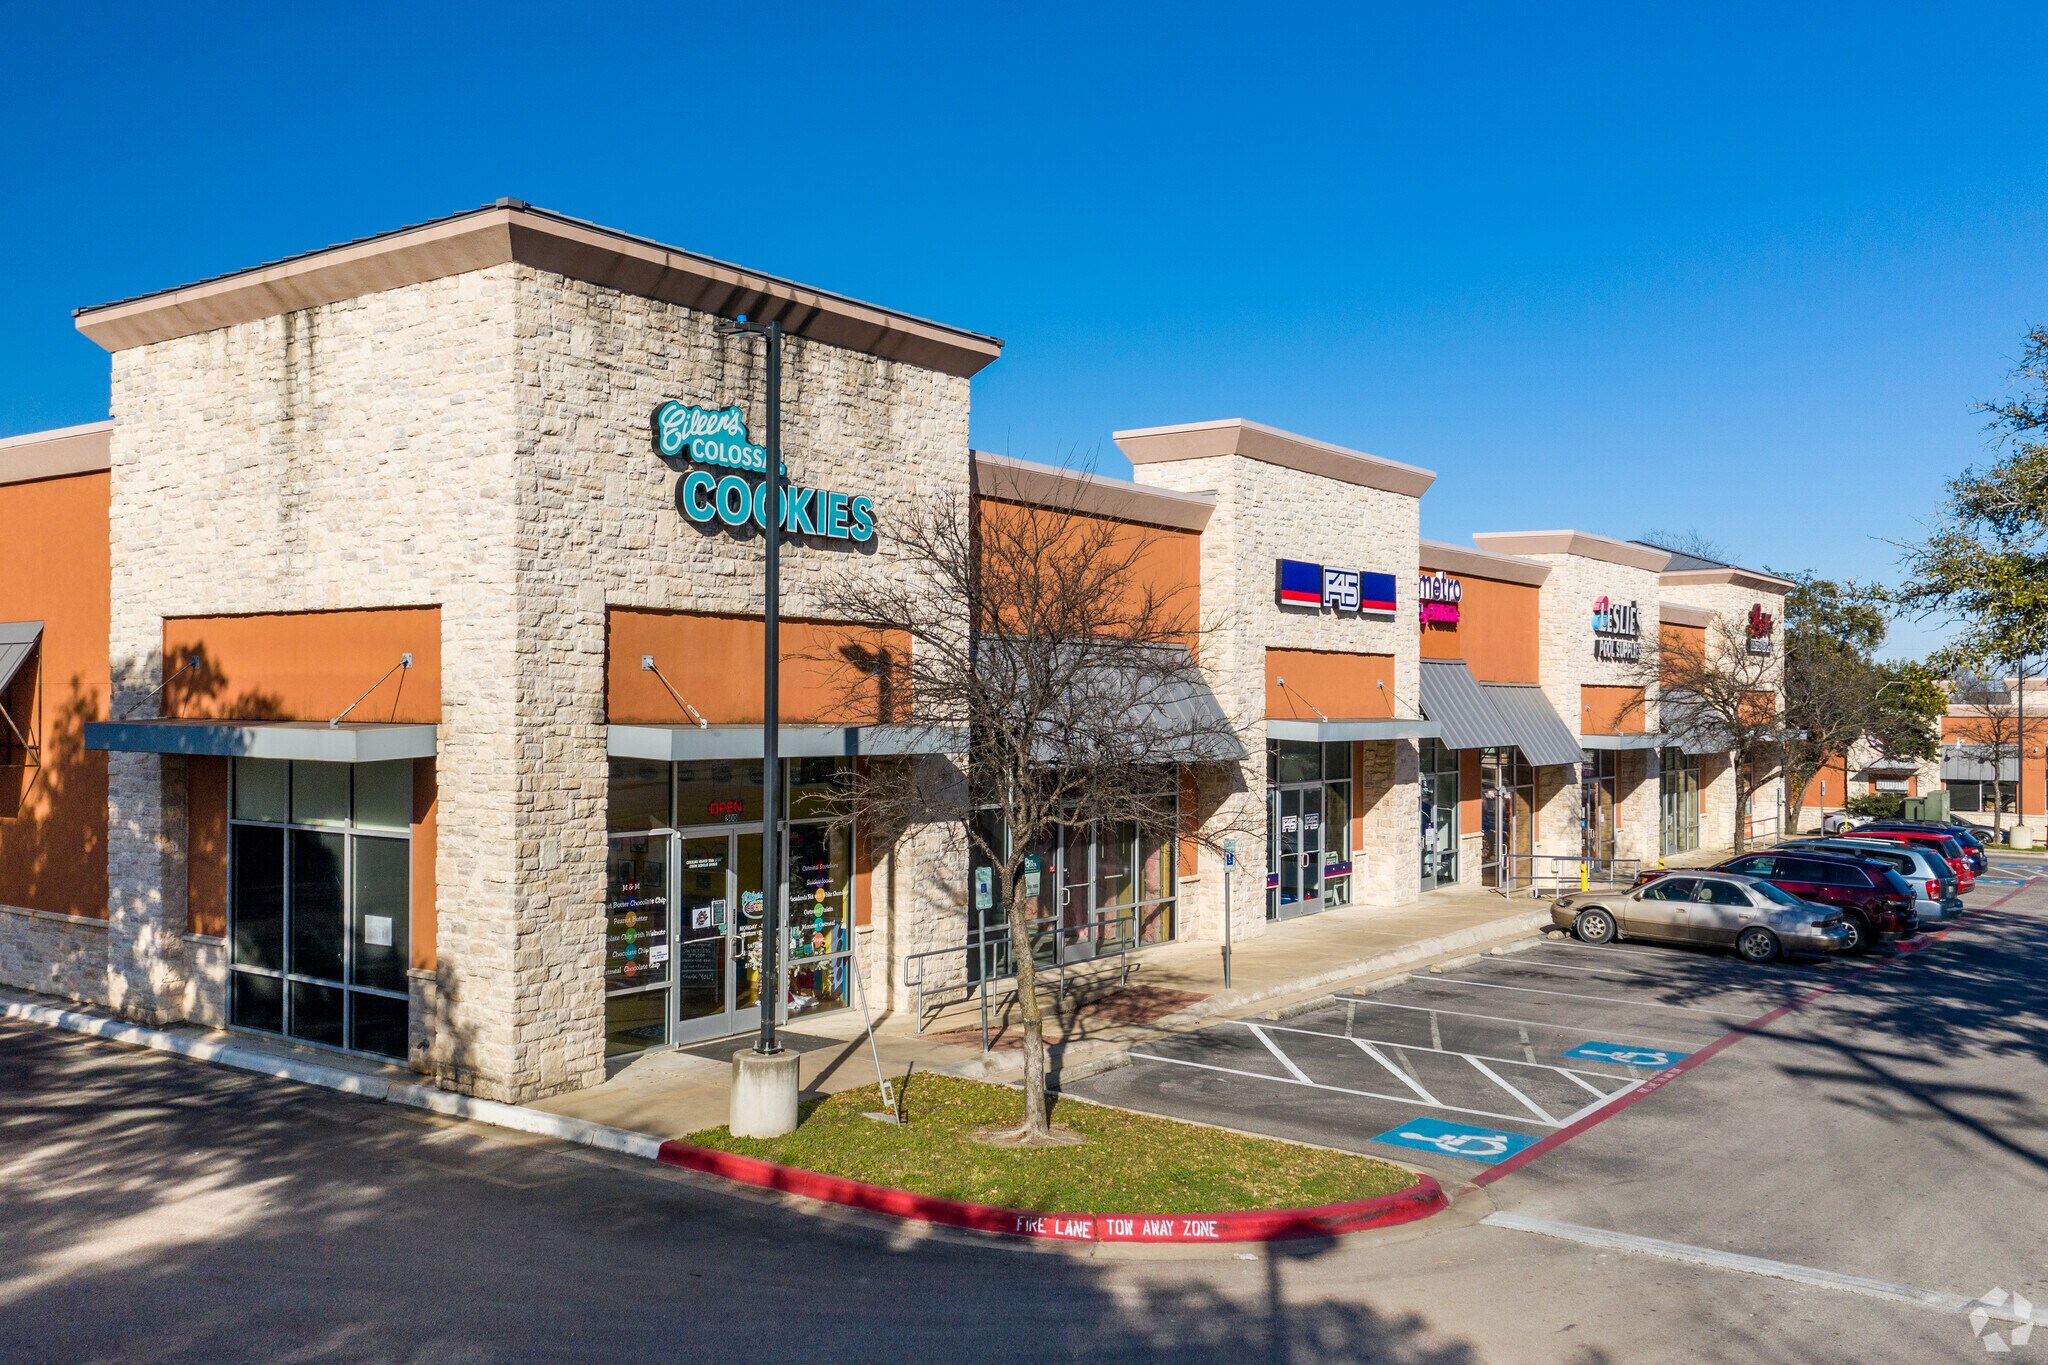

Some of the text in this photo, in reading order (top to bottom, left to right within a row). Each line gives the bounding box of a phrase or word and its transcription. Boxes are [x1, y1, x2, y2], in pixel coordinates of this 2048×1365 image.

[661, 404, 743, 451] Eileen's
[692, 438, 783, 473] COLOSS
[683, 470, 874, 541] COOKIES
[1324, 566, 1360, 611] F45
[1599, 640, 1614, 657] POOL
[709, 801, 742, 814] OPEN
[655, 896, 667, 905] Chip
[612, 949, 637, 958] Chocolate
[624, 964, 648, 973] Chocolate
[1016, 1215, 1219, 1239] FIRE LANE TOW AWAY ZONE
